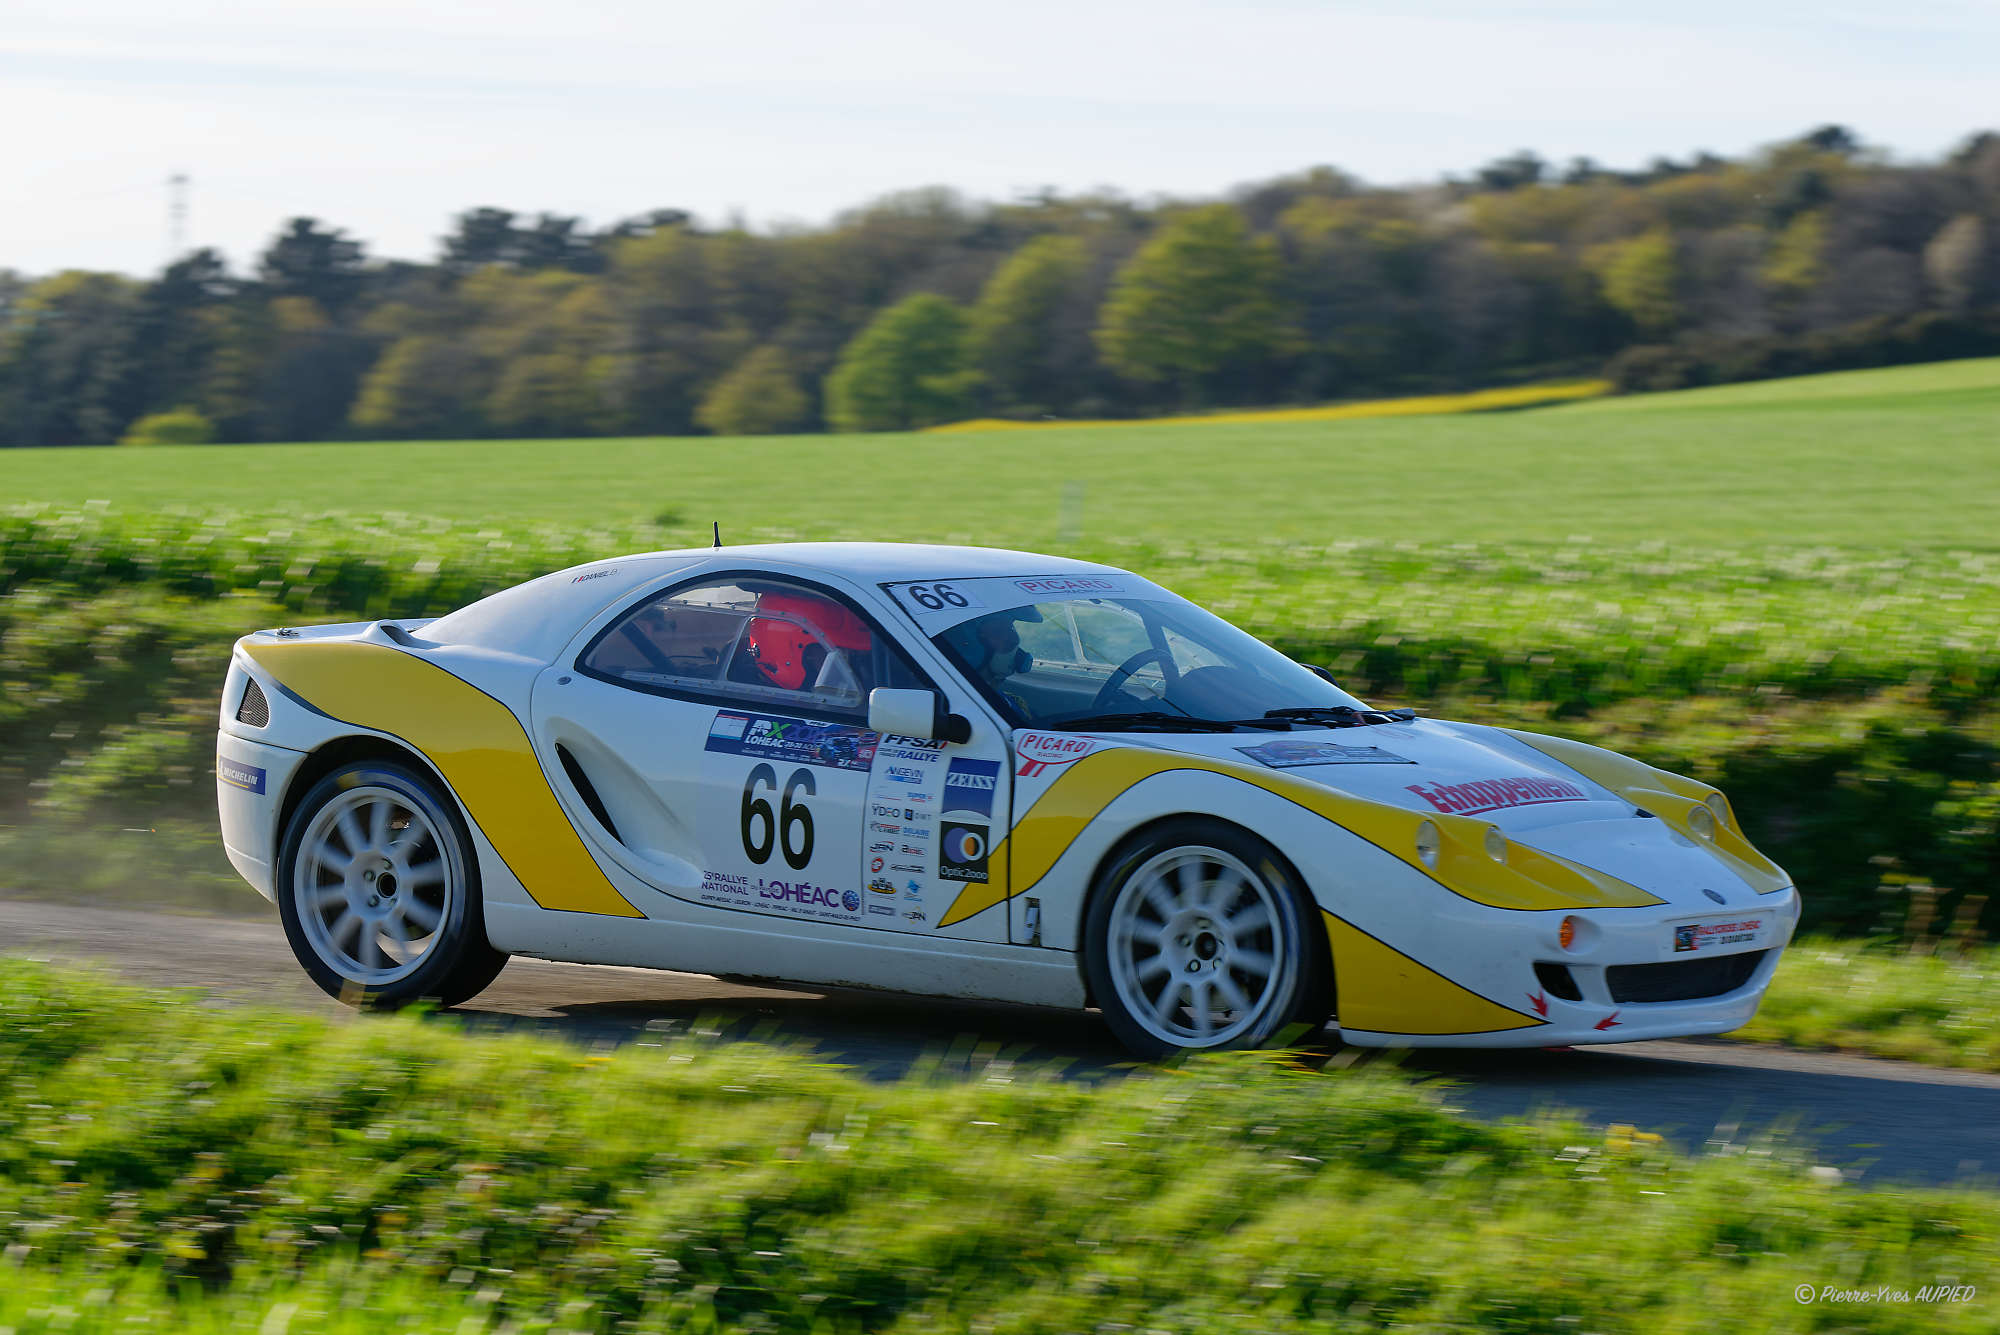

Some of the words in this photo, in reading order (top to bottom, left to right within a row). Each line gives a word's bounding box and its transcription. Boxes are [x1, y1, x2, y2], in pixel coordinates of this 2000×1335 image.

[1020, 579, 1113, 592] PICARD
[908, 583, 969, 610] 66
[744, 735, 785, 748] LOHEAC
[884, 733, 938, 749] FFSA
[1023, 735, 1088, 752] PICARD
[896, 750, 940, 763] RALLYE
[223, 767, 258, 785] MICHELIN
[945, 771, 996, 790] ZEISS
[741, 762, 817, 871] 66
[714, 872, 748, 886] RALLYE
[701, 881, 749, 896] NATIONAL
[758, 878, 840, 908] LOHÉAC
